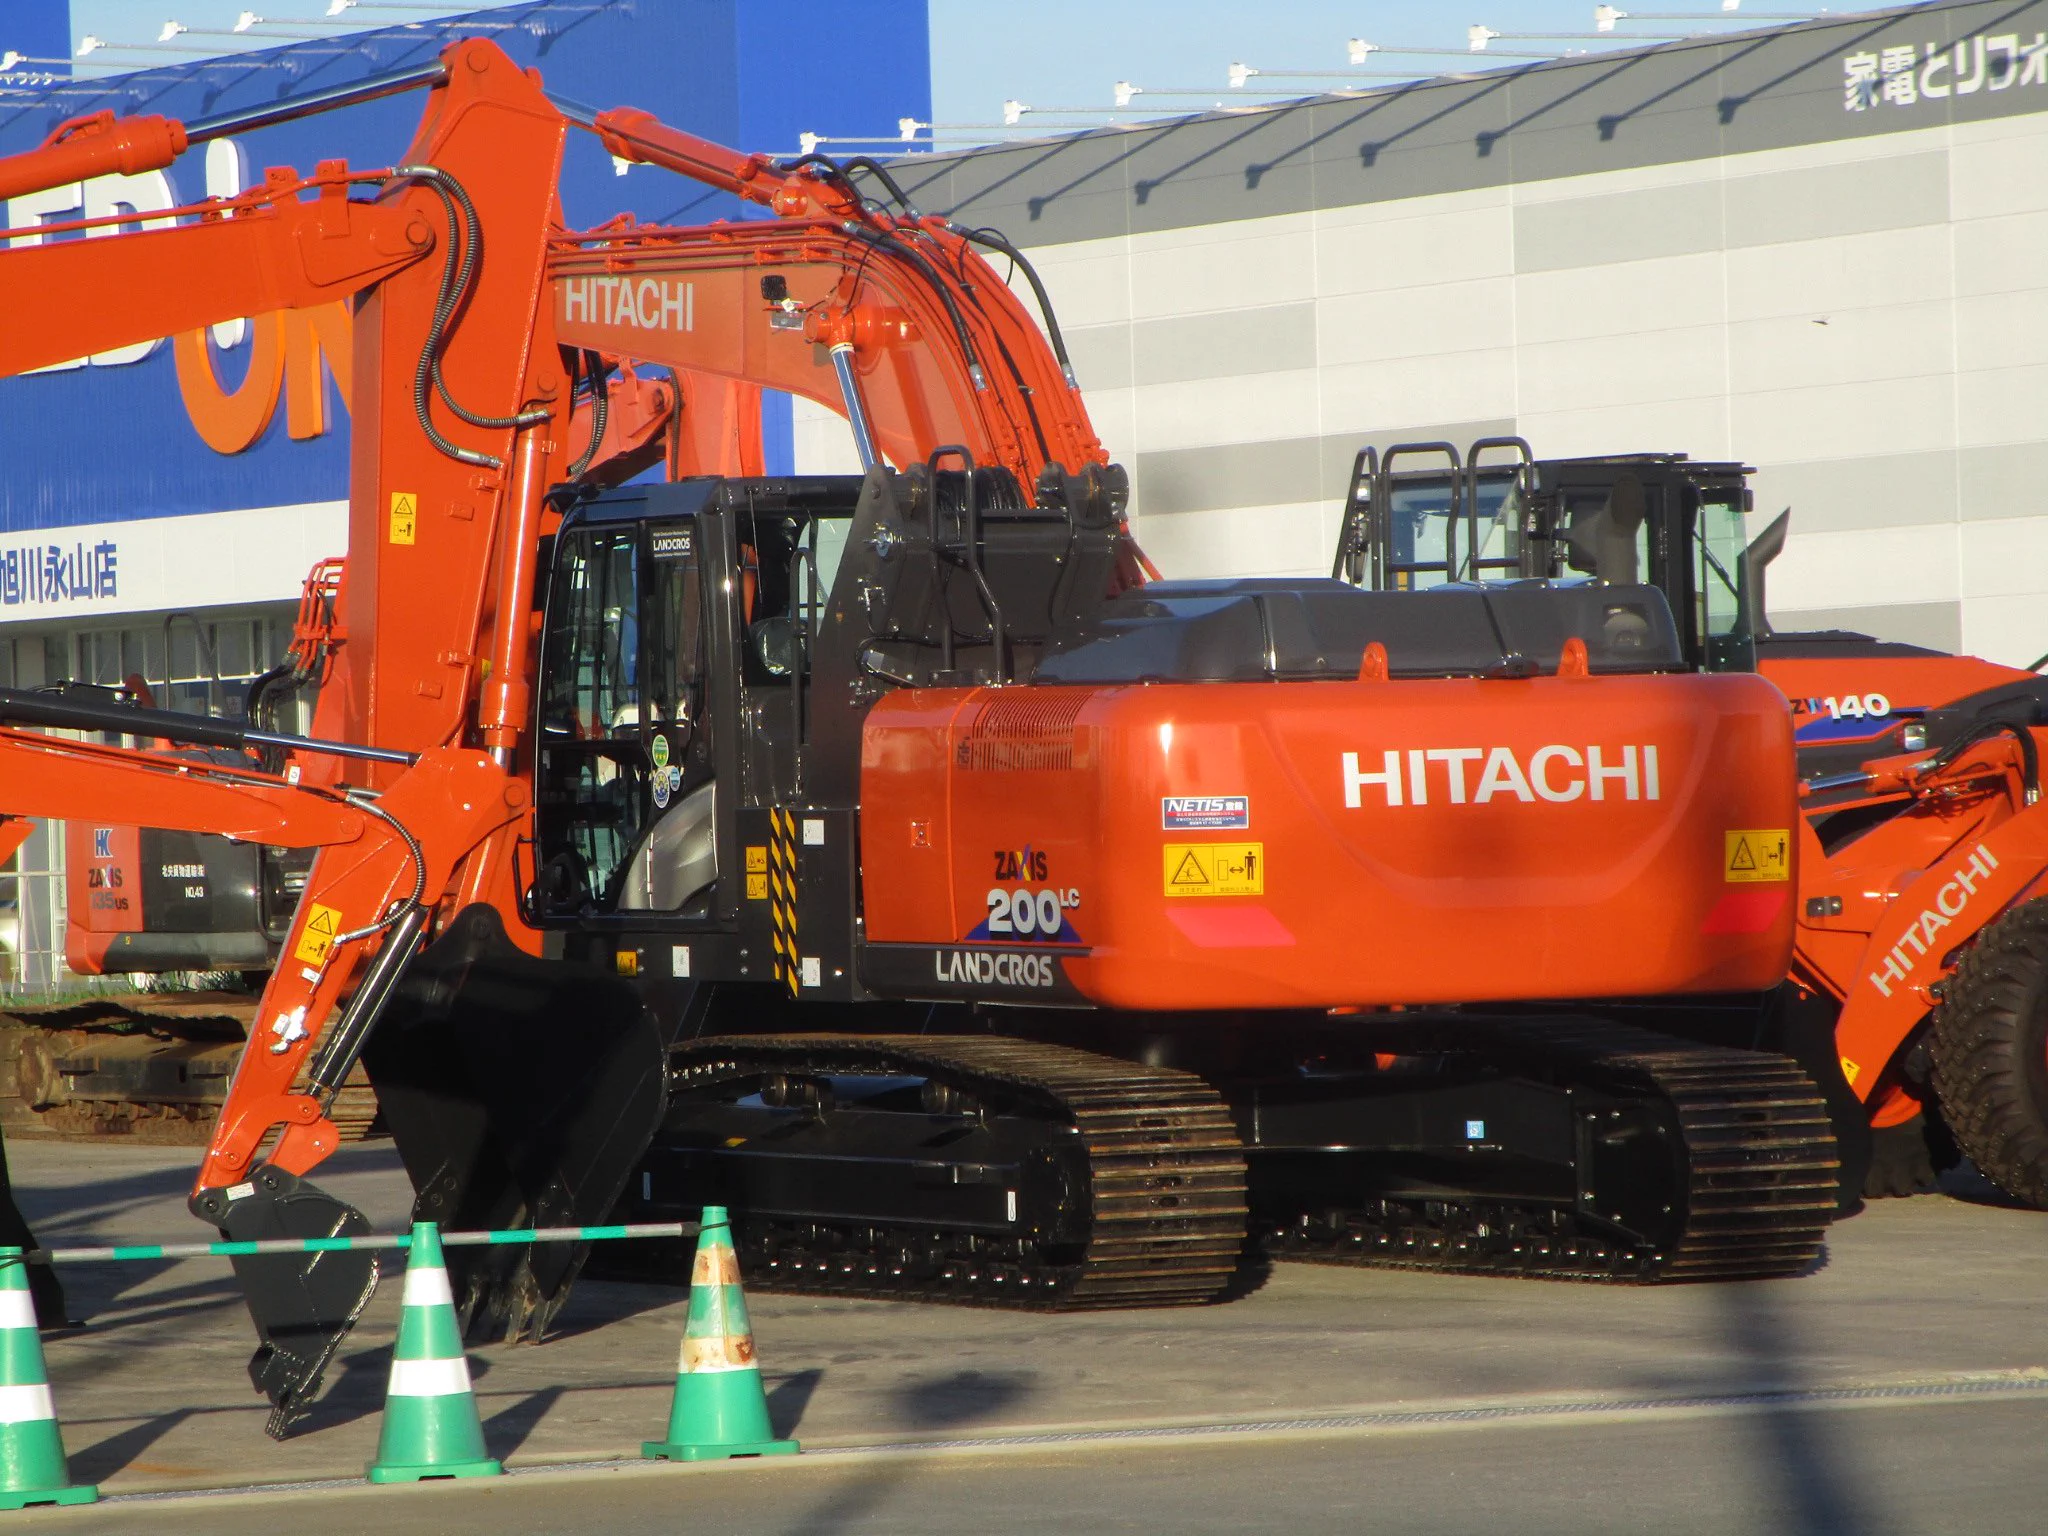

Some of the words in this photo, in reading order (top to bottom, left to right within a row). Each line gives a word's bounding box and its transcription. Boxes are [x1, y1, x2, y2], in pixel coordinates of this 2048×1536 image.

[565, 276, 693, 331] HITACHI
[653, 538, 691, 551] LANDCROS
[0, 540, 117, 605] 旭川永山店
[1342, 745, 1660, 808] HITACHI
[1168, 799, 1224, 812] NETIS
[88, 864, 122, 888] ZAXIS
[994, 843, 1048, 882] ZAXIS
[1869, 843, 2000, 998] HITACHI
[935, 950, 1054, 987] LANDCROS
